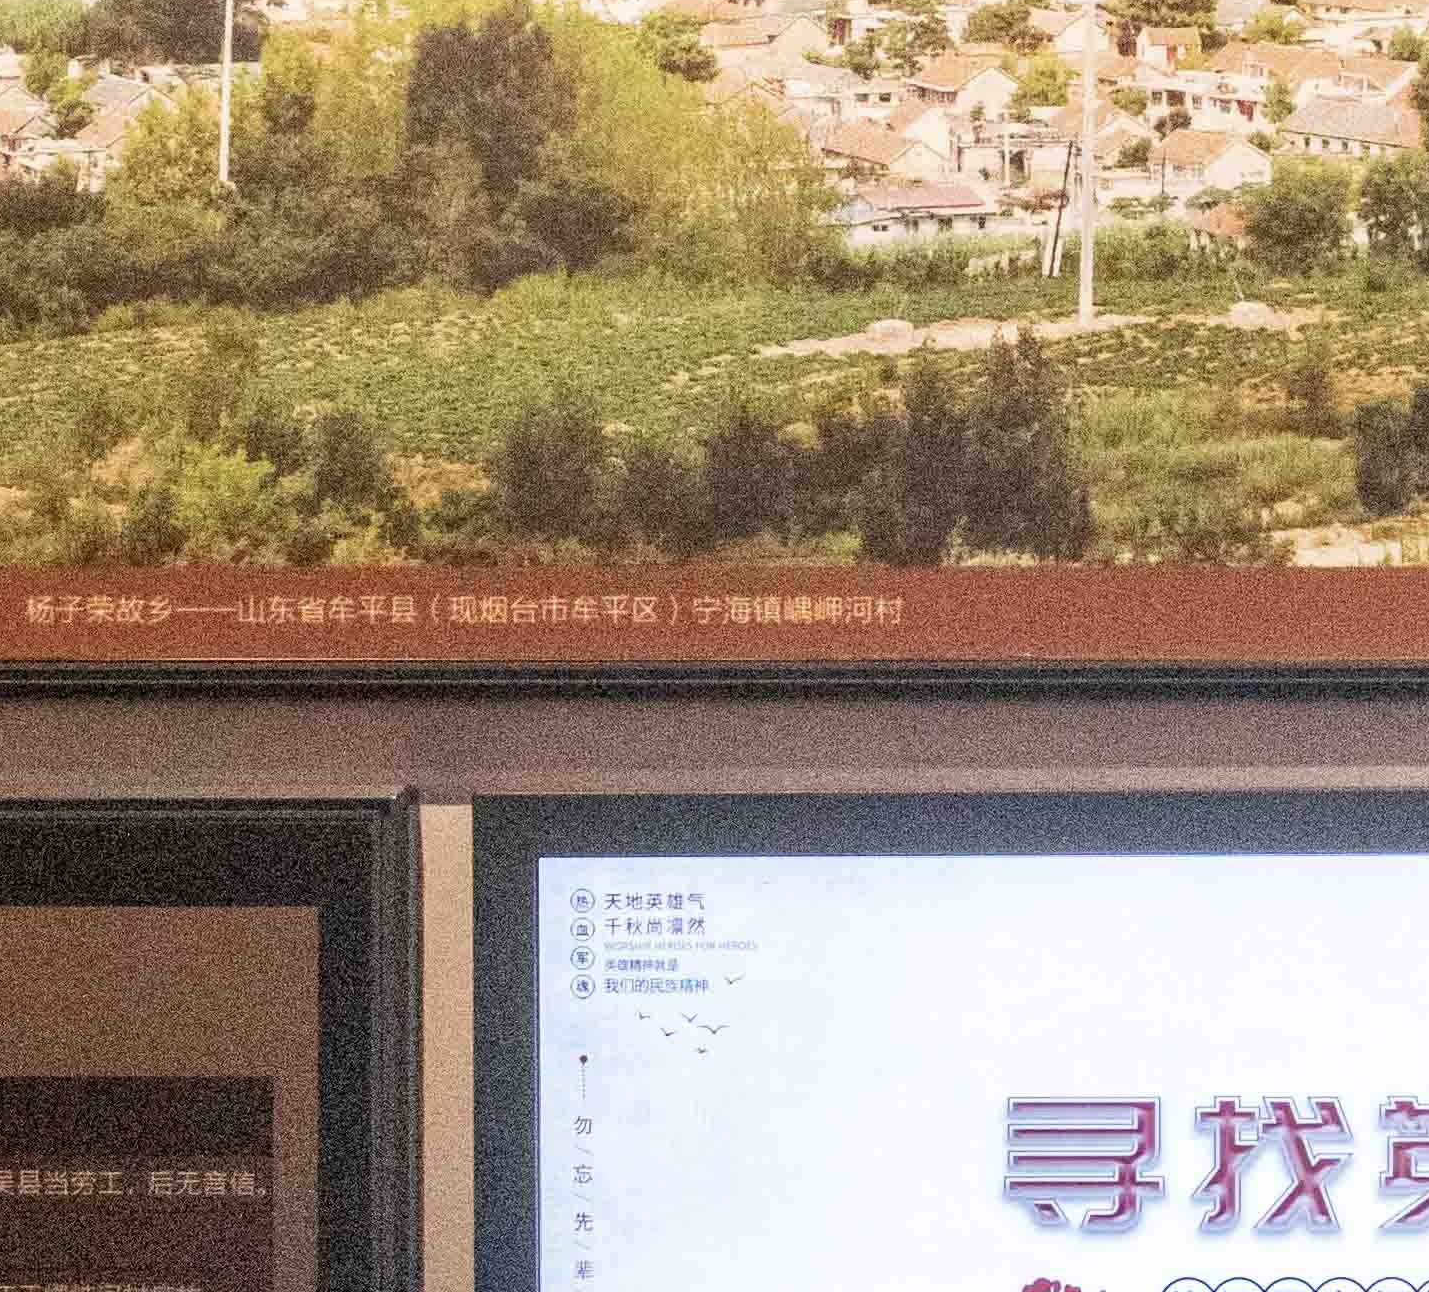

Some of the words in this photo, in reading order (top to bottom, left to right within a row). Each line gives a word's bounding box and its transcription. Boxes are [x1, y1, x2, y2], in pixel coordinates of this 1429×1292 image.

[604, 893, 706, 910] 天地英雄气
